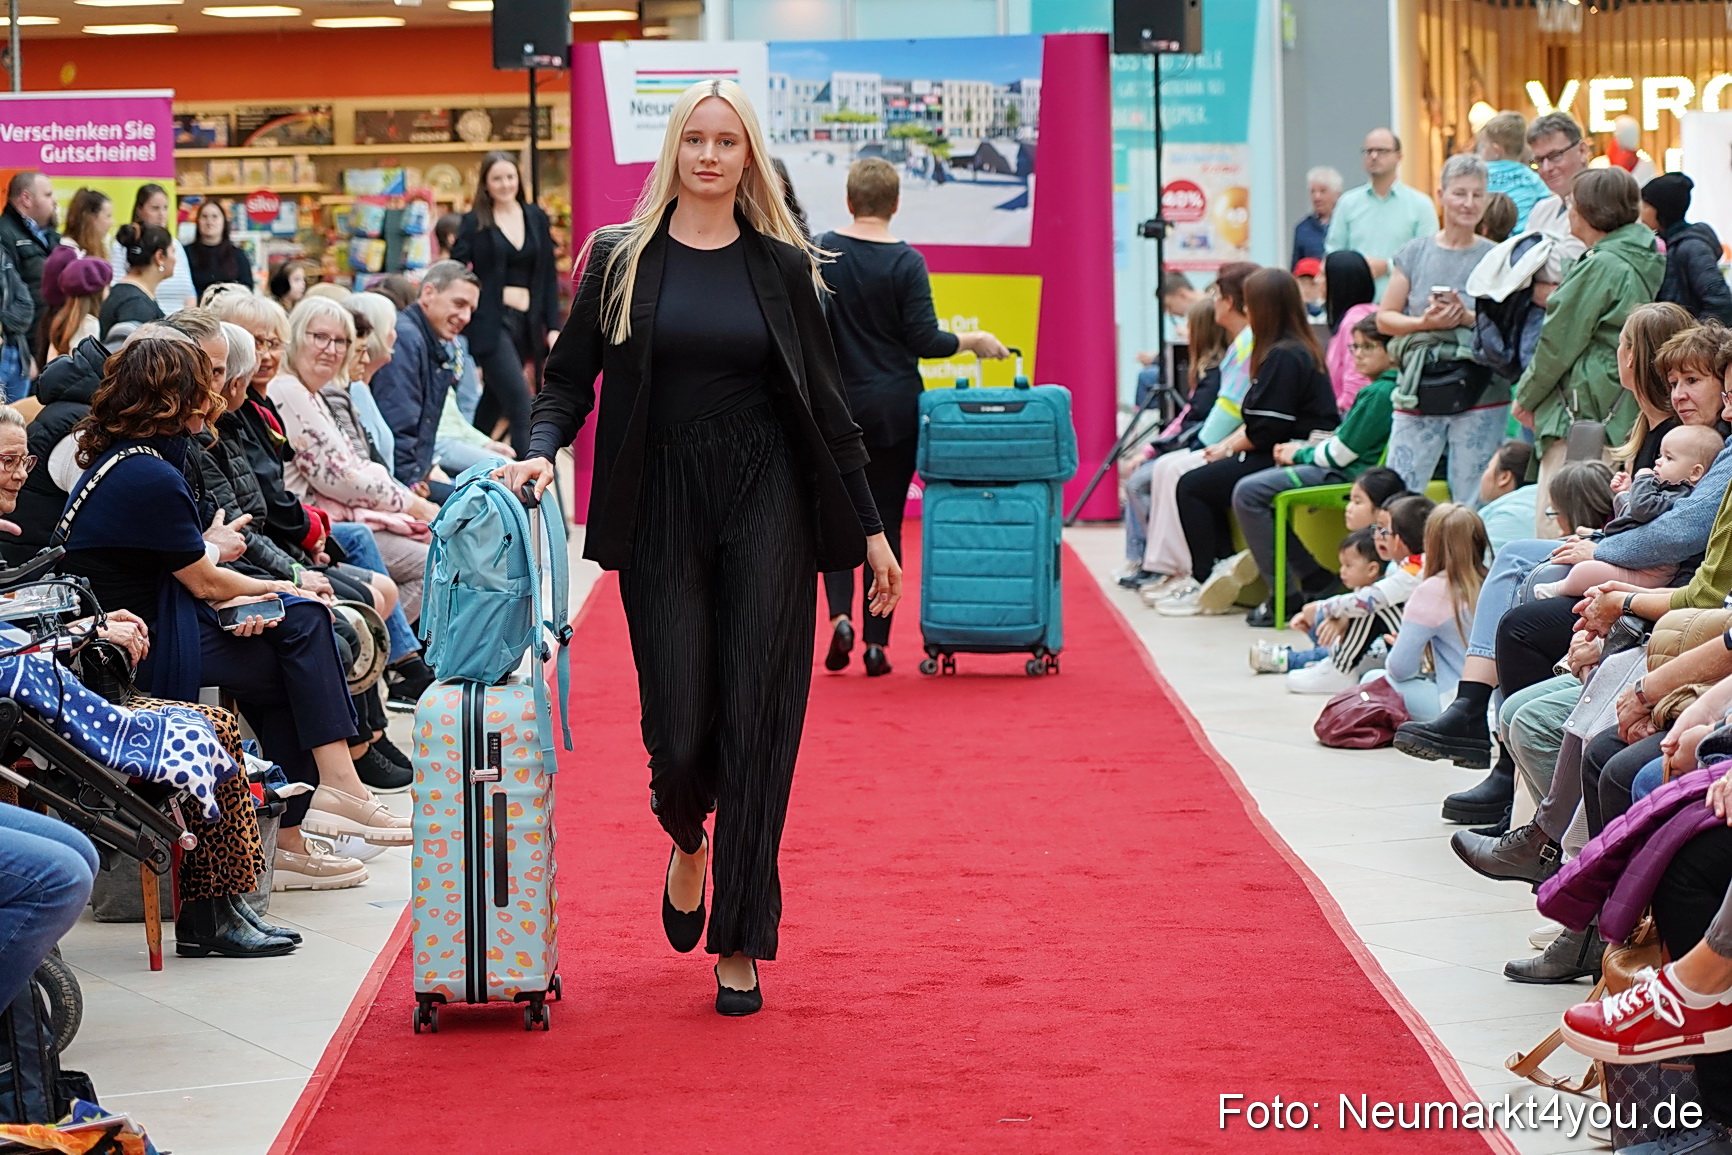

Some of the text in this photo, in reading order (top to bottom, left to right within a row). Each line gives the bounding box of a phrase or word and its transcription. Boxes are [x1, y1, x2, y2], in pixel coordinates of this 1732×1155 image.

[0, 120, 156, 142] Verschenken Sie
[40, 141, 157, 163] Gutscheine!
